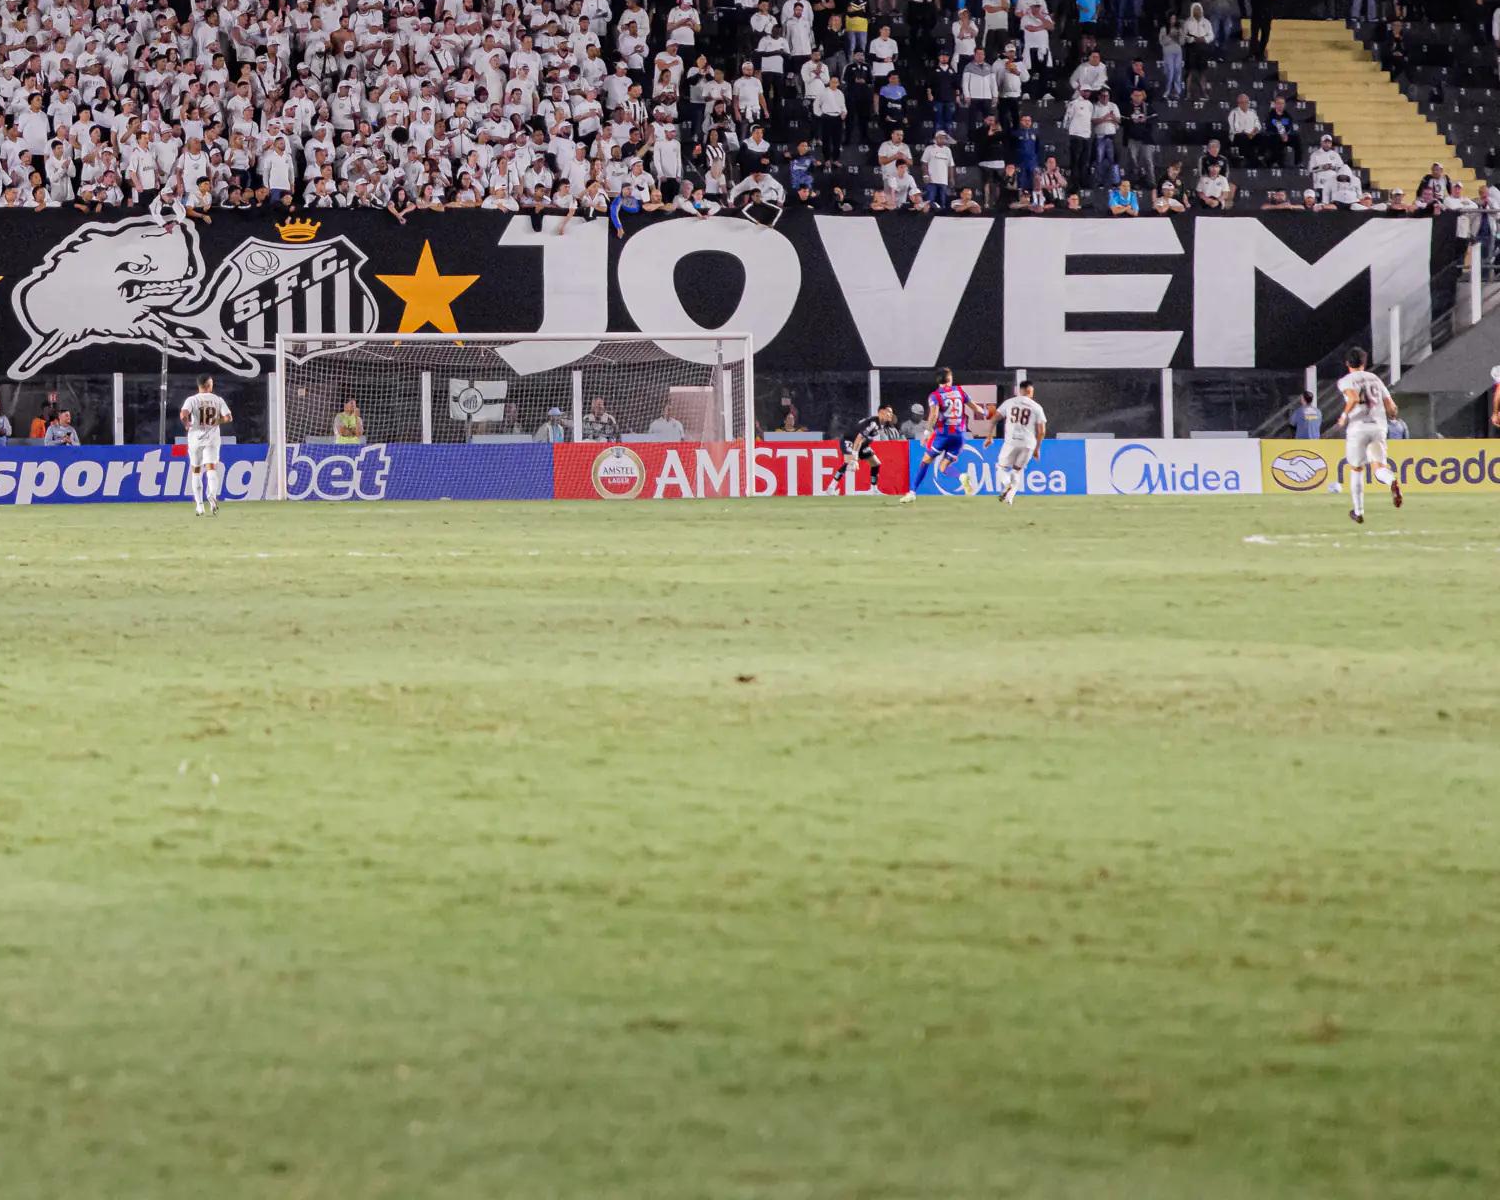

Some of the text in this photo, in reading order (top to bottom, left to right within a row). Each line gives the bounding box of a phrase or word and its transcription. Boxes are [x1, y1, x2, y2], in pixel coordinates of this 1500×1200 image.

[233, 247, 350, 323] S.F.C.
[498, 215, 1433, 377] JOVEM
[198, 406, 216, 426] 18
[944, 398, 962, 418] 29
[1010, 407, 1031, 426] 98
[602, 466, 635, 475] AMSTEL
[653, 448, 880, 499] AMSTEL
[1132, 462, 1240, 495] Midea
